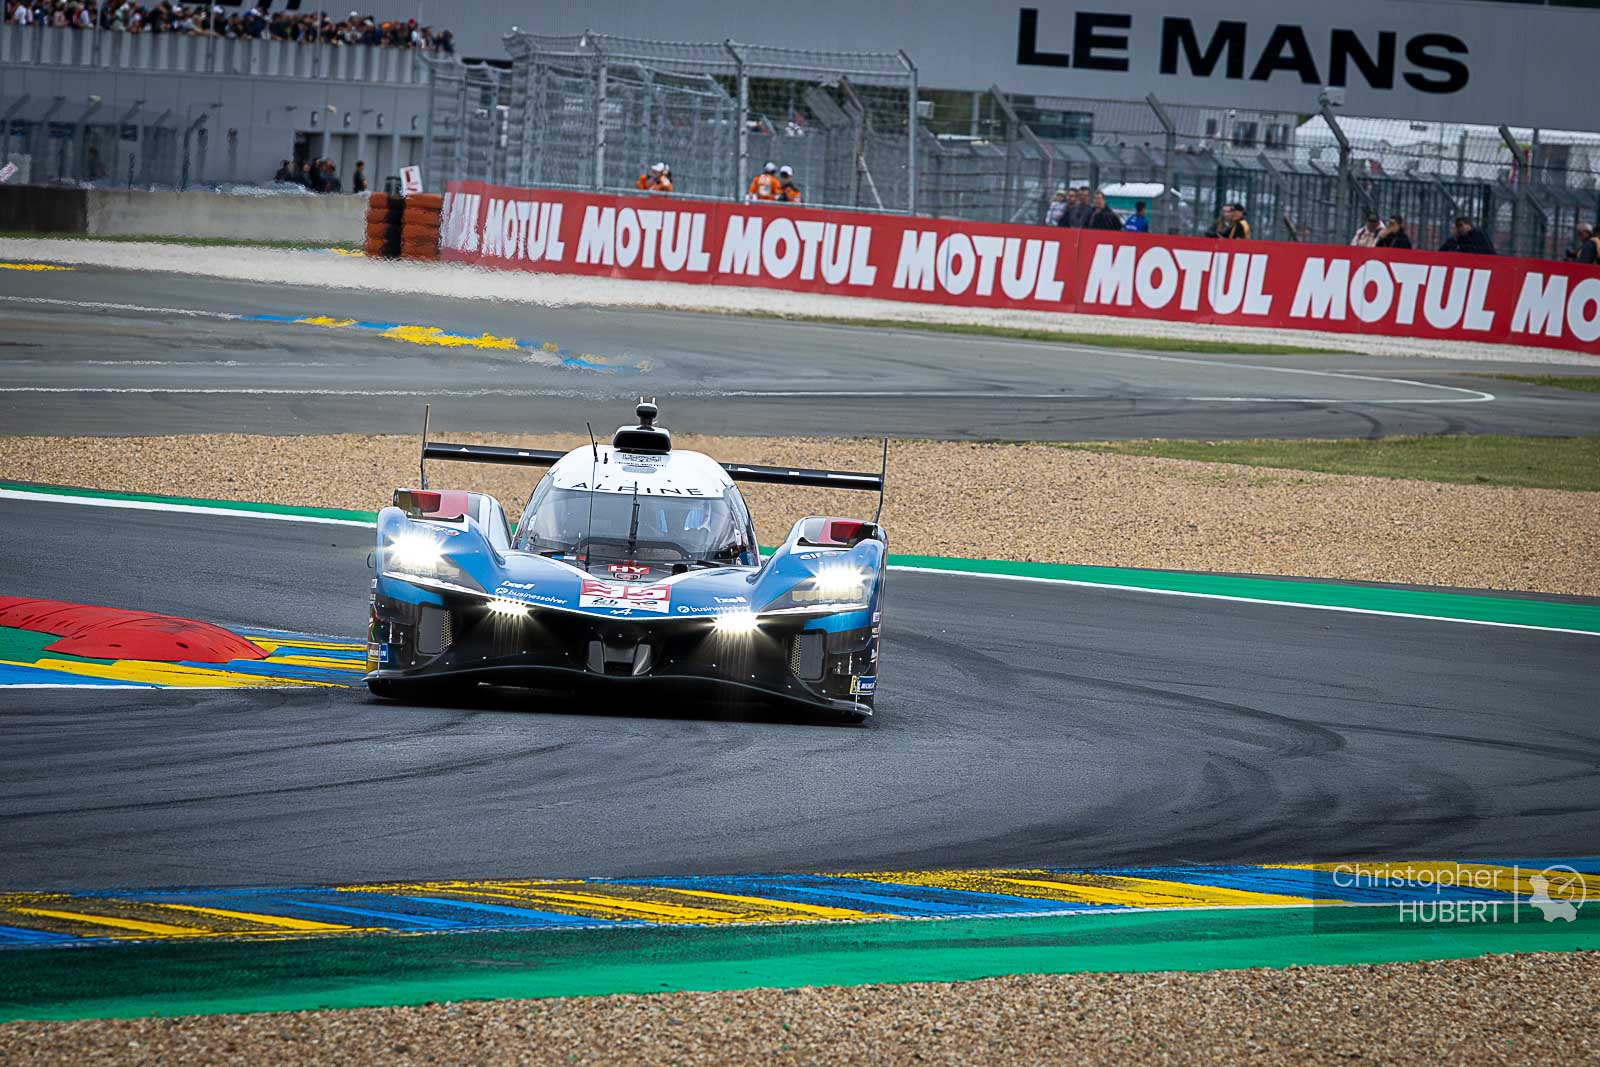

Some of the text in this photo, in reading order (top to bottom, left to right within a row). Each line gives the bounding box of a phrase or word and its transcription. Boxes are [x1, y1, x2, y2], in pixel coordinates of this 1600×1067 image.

[1017, 8, 1470, 94] LE MANS
[481, 198, 565, 262] MOTUL
[575, 205, 710, 273] MOTUL
[718, 215, 878, 286] MOTUL
[892, 229, 1064, 301] MOTUL
[1083, 243, 1272, 315] MOTUL
[1290, 256, 1495, 336] MOTUL
[570, 481, 704, 496] ALPINE
[609, 564, 647, 574] HY
[508, 589, 568, 605] businessolver
